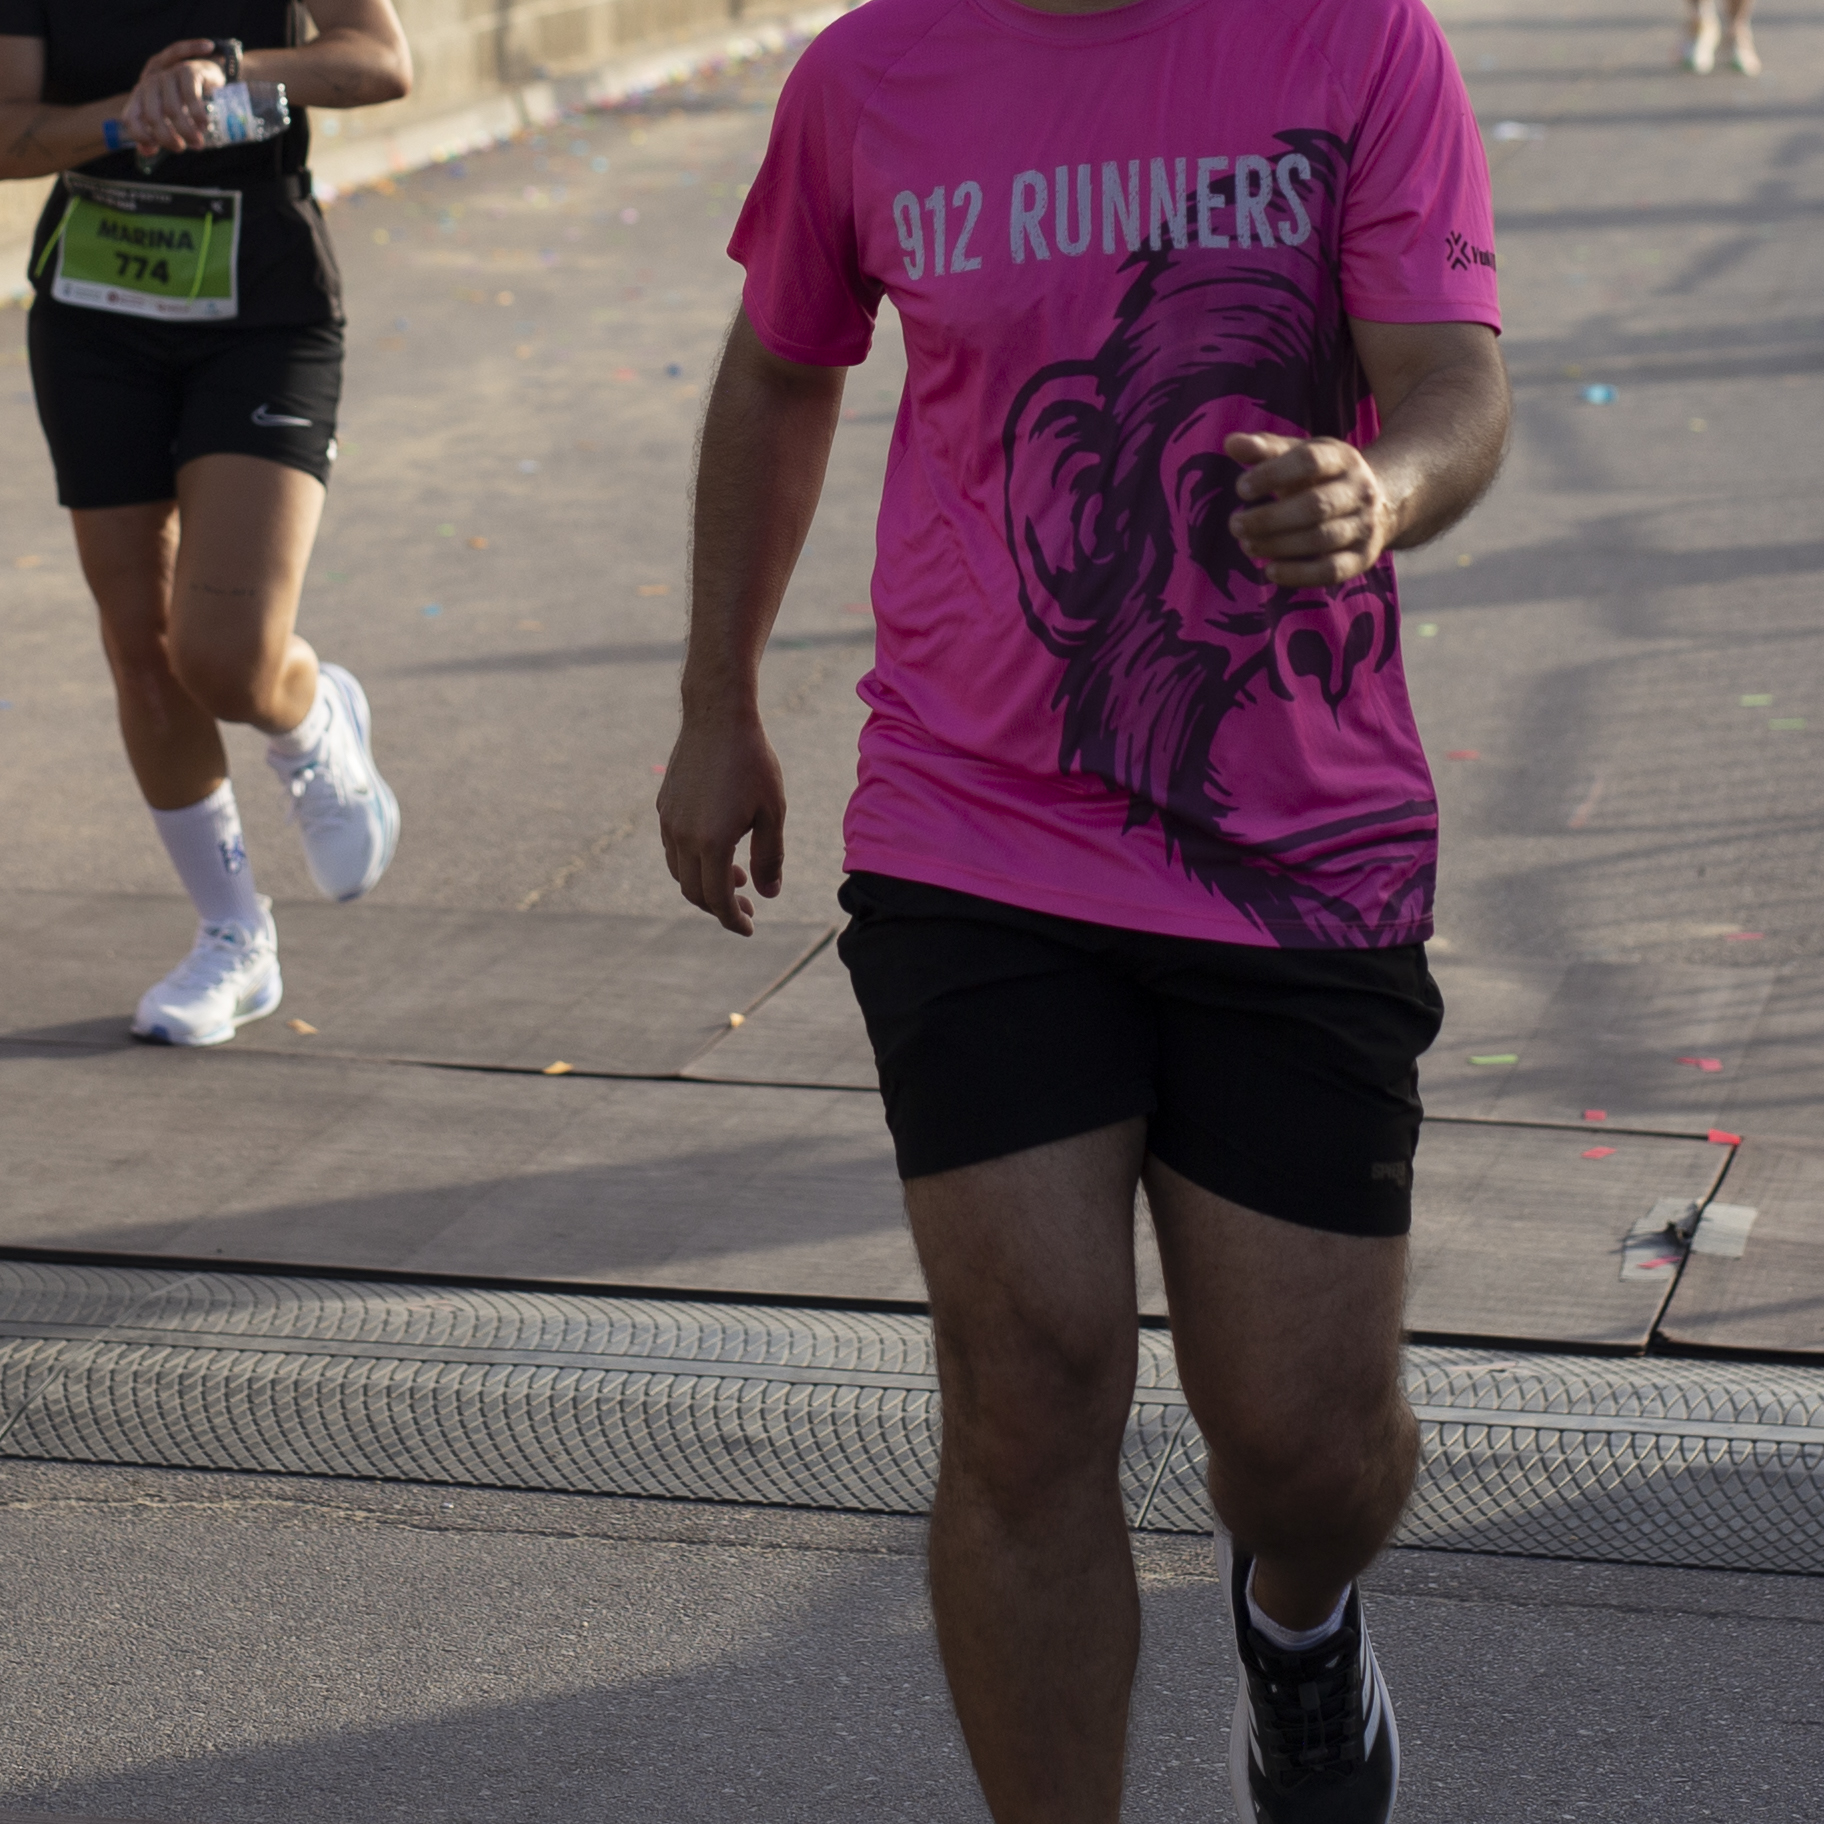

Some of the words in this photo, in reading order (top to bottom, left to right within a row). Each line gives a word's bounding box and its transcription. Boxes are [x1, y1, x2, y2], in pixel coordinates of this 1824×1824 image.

[892, 180, 983, 281] 912
[1009, 152, 1313, 265] RUNNERS
[96, 218, 195, 253] MARINA
[114, 250, 171, 285] 774
